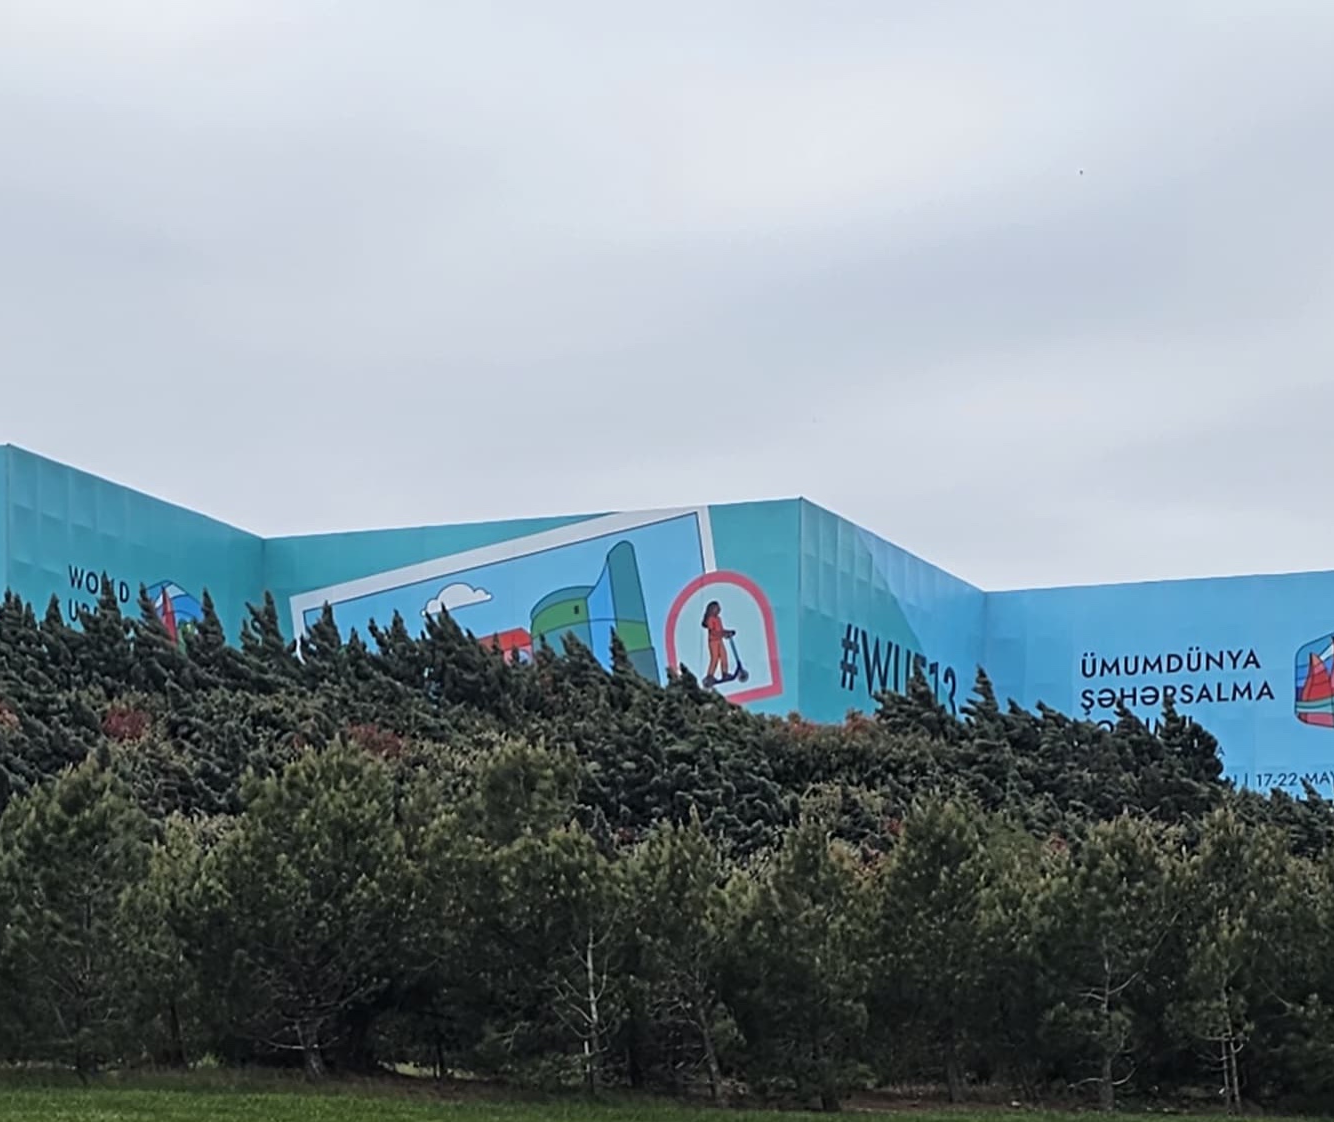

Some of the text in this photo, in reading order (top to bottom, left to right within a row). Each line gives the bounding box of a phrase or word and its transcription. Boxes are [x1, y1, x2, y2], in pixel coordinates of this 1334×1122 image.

[1081, 646, 1261, 678] ÜMUMDÜNYA
[1080, 681, 1275, 716] ŞƏHƏRSALMA
[1256, 772, 1298, 787] 17-22
